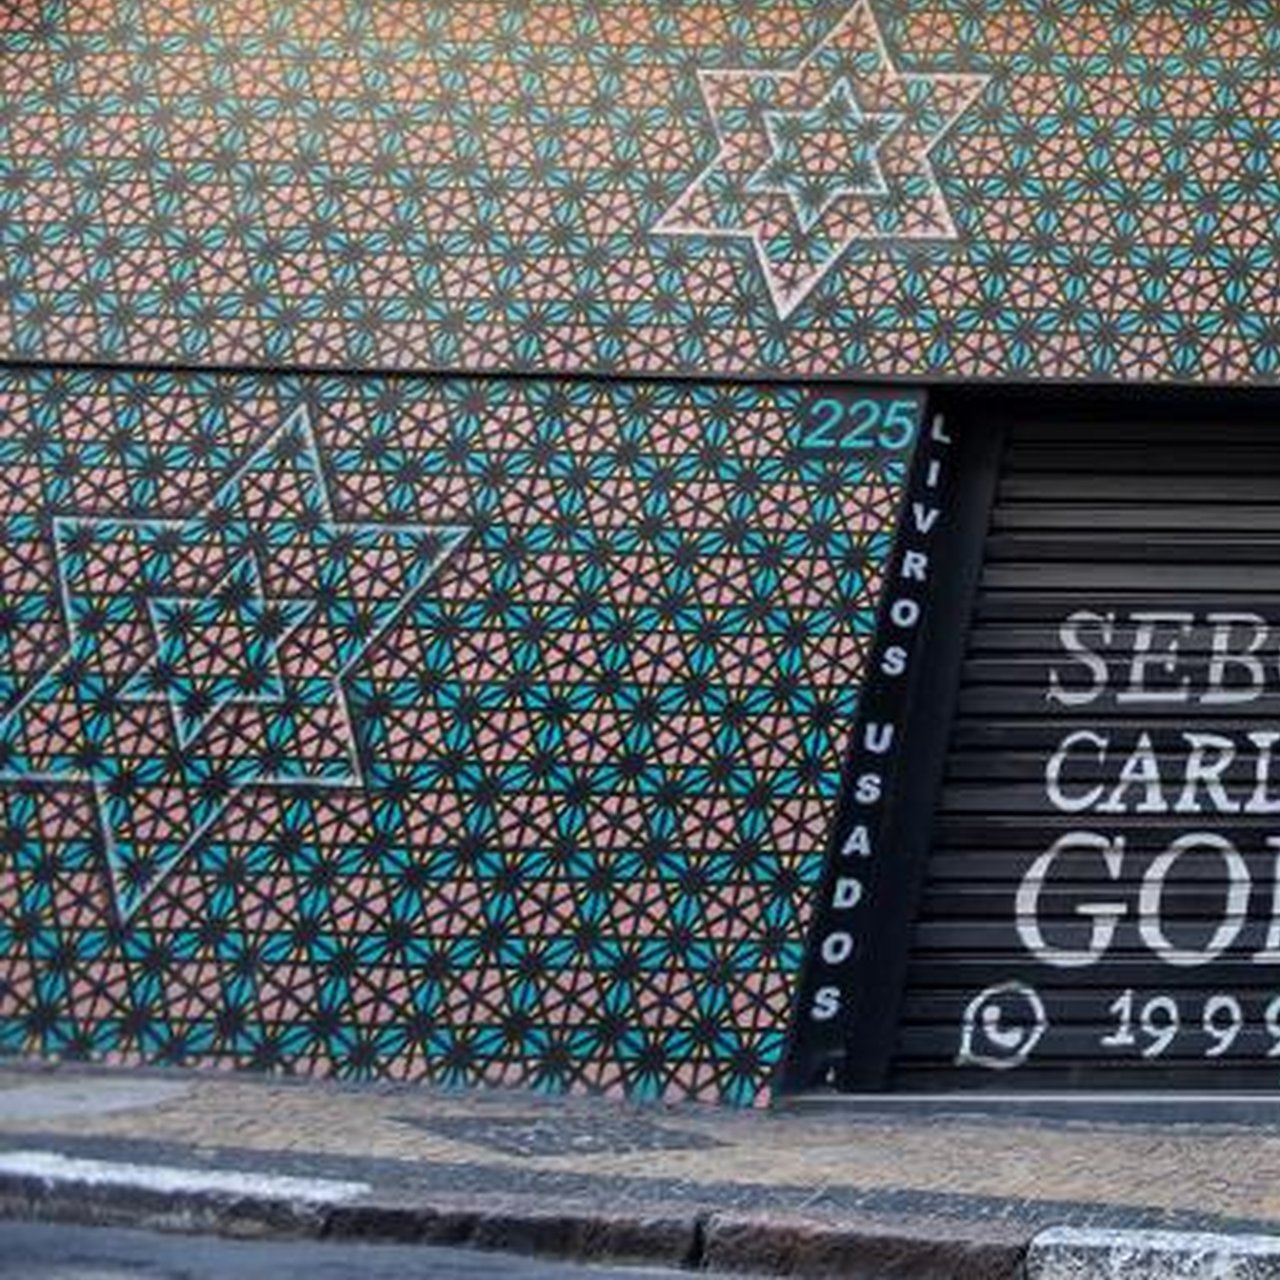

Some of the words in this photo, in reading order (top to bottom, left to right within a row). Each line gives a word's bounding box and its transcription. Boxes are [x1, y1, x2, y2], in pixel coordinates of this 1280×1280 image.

[800, 398, 918, 449] 225
[880, 413, 951, 676] LIVROS
[810, 722, 894, 1020] USADOS
[1101, 989, 1180, 1058] 19
[1202, 995, 1243, 1057] 9
